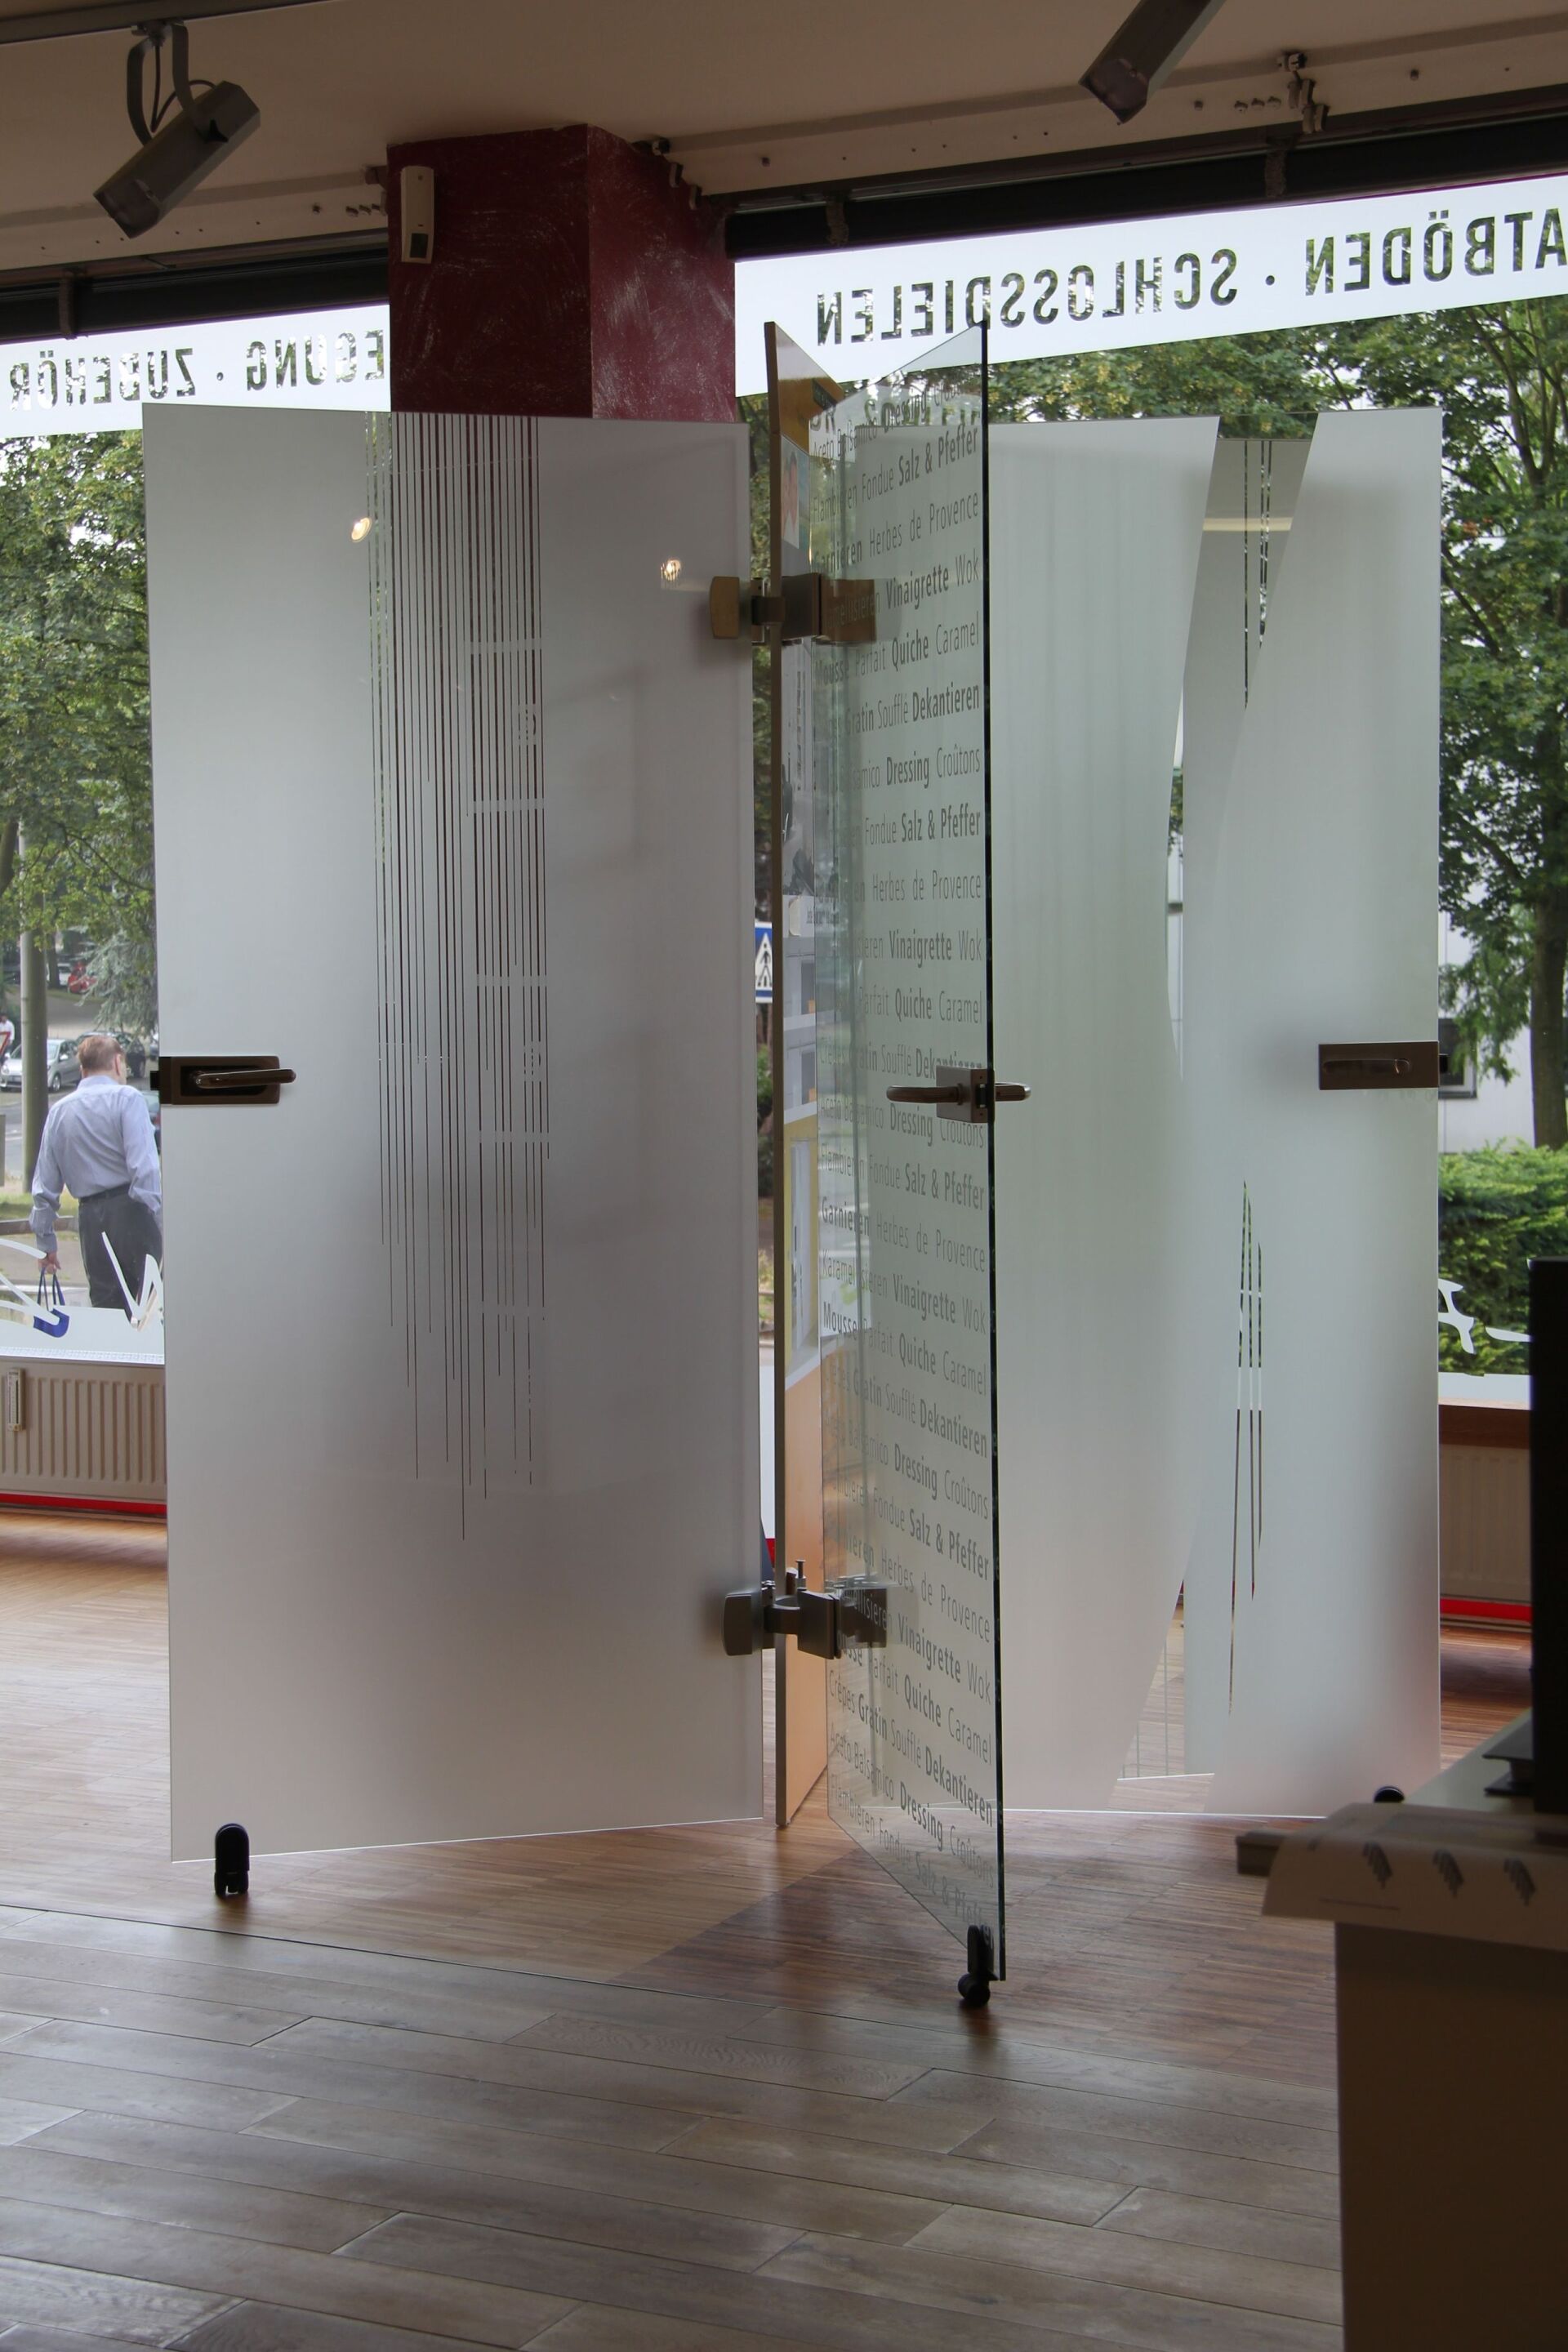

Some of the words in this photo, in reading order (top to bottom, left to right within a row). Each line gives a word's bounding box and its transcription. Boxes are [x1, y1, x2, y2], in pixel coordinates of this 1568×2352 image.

[862, 464, 894, 503] Fondue
[898, 448, 920, 487] Salz
[924, 442, 933, 473] &
[938, 424, 978, 469] Pfeffer
[870, 521, 902, 558] Herbes
[909, 509, 922, 542] de
[929, 492, 978, 536] Provence
[885, 564, 950, 610] Vinaigrette
[955, 548, 980, 586] Wok
[855, 641, 886, 676] Parfait
[892, 629, 929, 671] Quiche
[935, 610, 980, 656] Caramel
[877, 692, 909, 730] Soufflé
[912, 681, 979, 723] Dekantieren
[886, 751, 929, 789] Dressing
[936, 743, 981, 779] Croûtons
[865, 813, 898, 845] Fondue
[902, 809, 923, 843] Salz
[928, 809, 936, 840] &
[940, 803, 981, 840] Pfeffer
[872, 869, 905, 902] Herbes
[912, 868, 924, 901] de
[932, 869, 982, 900] Provence
[889, 928, 952, 969] Vinaigrette
[958, 928, 982, 961] Wok
[858, 984, 889, 1017] Parfait
[895, 987, 933, 1022] Quiche
[939, 990, 983, 1025] Caramel
[881, 1043, 912, 1076] Soufflé
[889, 1102, 933, 1147] Dressing
[869, 1154, 901, 1190] Fondue
[905, 1163, 926, 1196] Salz
[931, 1169, 939, 1199] &
[944, 1171, 985, 1210] Pfeffer
[876, 1210, 909, 1249] Herbes
[915, 1223, 929, 1255] de
[936, 1228, 986, 1272] Provence
[893, 1273, 956, 1325] Vinaigrette
[962, 1296, 987, 1335] Wok
[823, 1301, 858, 1340] Mousse
[899, 1332, 937, 1375] Quiche
[942, 1350, 987, 1396] Caramel
[884, 1383, 916, 1423] Soufflé
[920, 1397, 987, 1459] Dekantieren
[894, 1443, 938, 1501] Dressing
[944, 1469, 988, 1520] Croûtons
[873, 1486, 906, 1532] Fondue
[909, 1508, 931, 1548] Salz
[935, 1523, 944, 1556] &
[948, 1530, 989, 1581] Pfeffer
[880, 1546, 915, 1593] Herbes
[920, 1571, 933, 1606] de
[941, 1584, 991, 1644] Provence
[898, 1612, 961, 1684] Vinaigrette
[966, 1659, 991, 1707] Wok
[903, 1674, 942, 1727] Quiche
[947, 1706, 992, 1766] Caramel
[858, 1693, 888, 1741] Gratin
[891, 1718, 922, 1769] Soufflé
[924, 1745, 993, 1829] Dekantieren
[853, 1741, 895, 1802] Balsamico
[899, 1780, 943, 1852] Dressing
[949, 1824, 995, 1889] Croûtons
[915, 1851, 938, 1896] Salz
[941, 1874, 950, 1909] &
